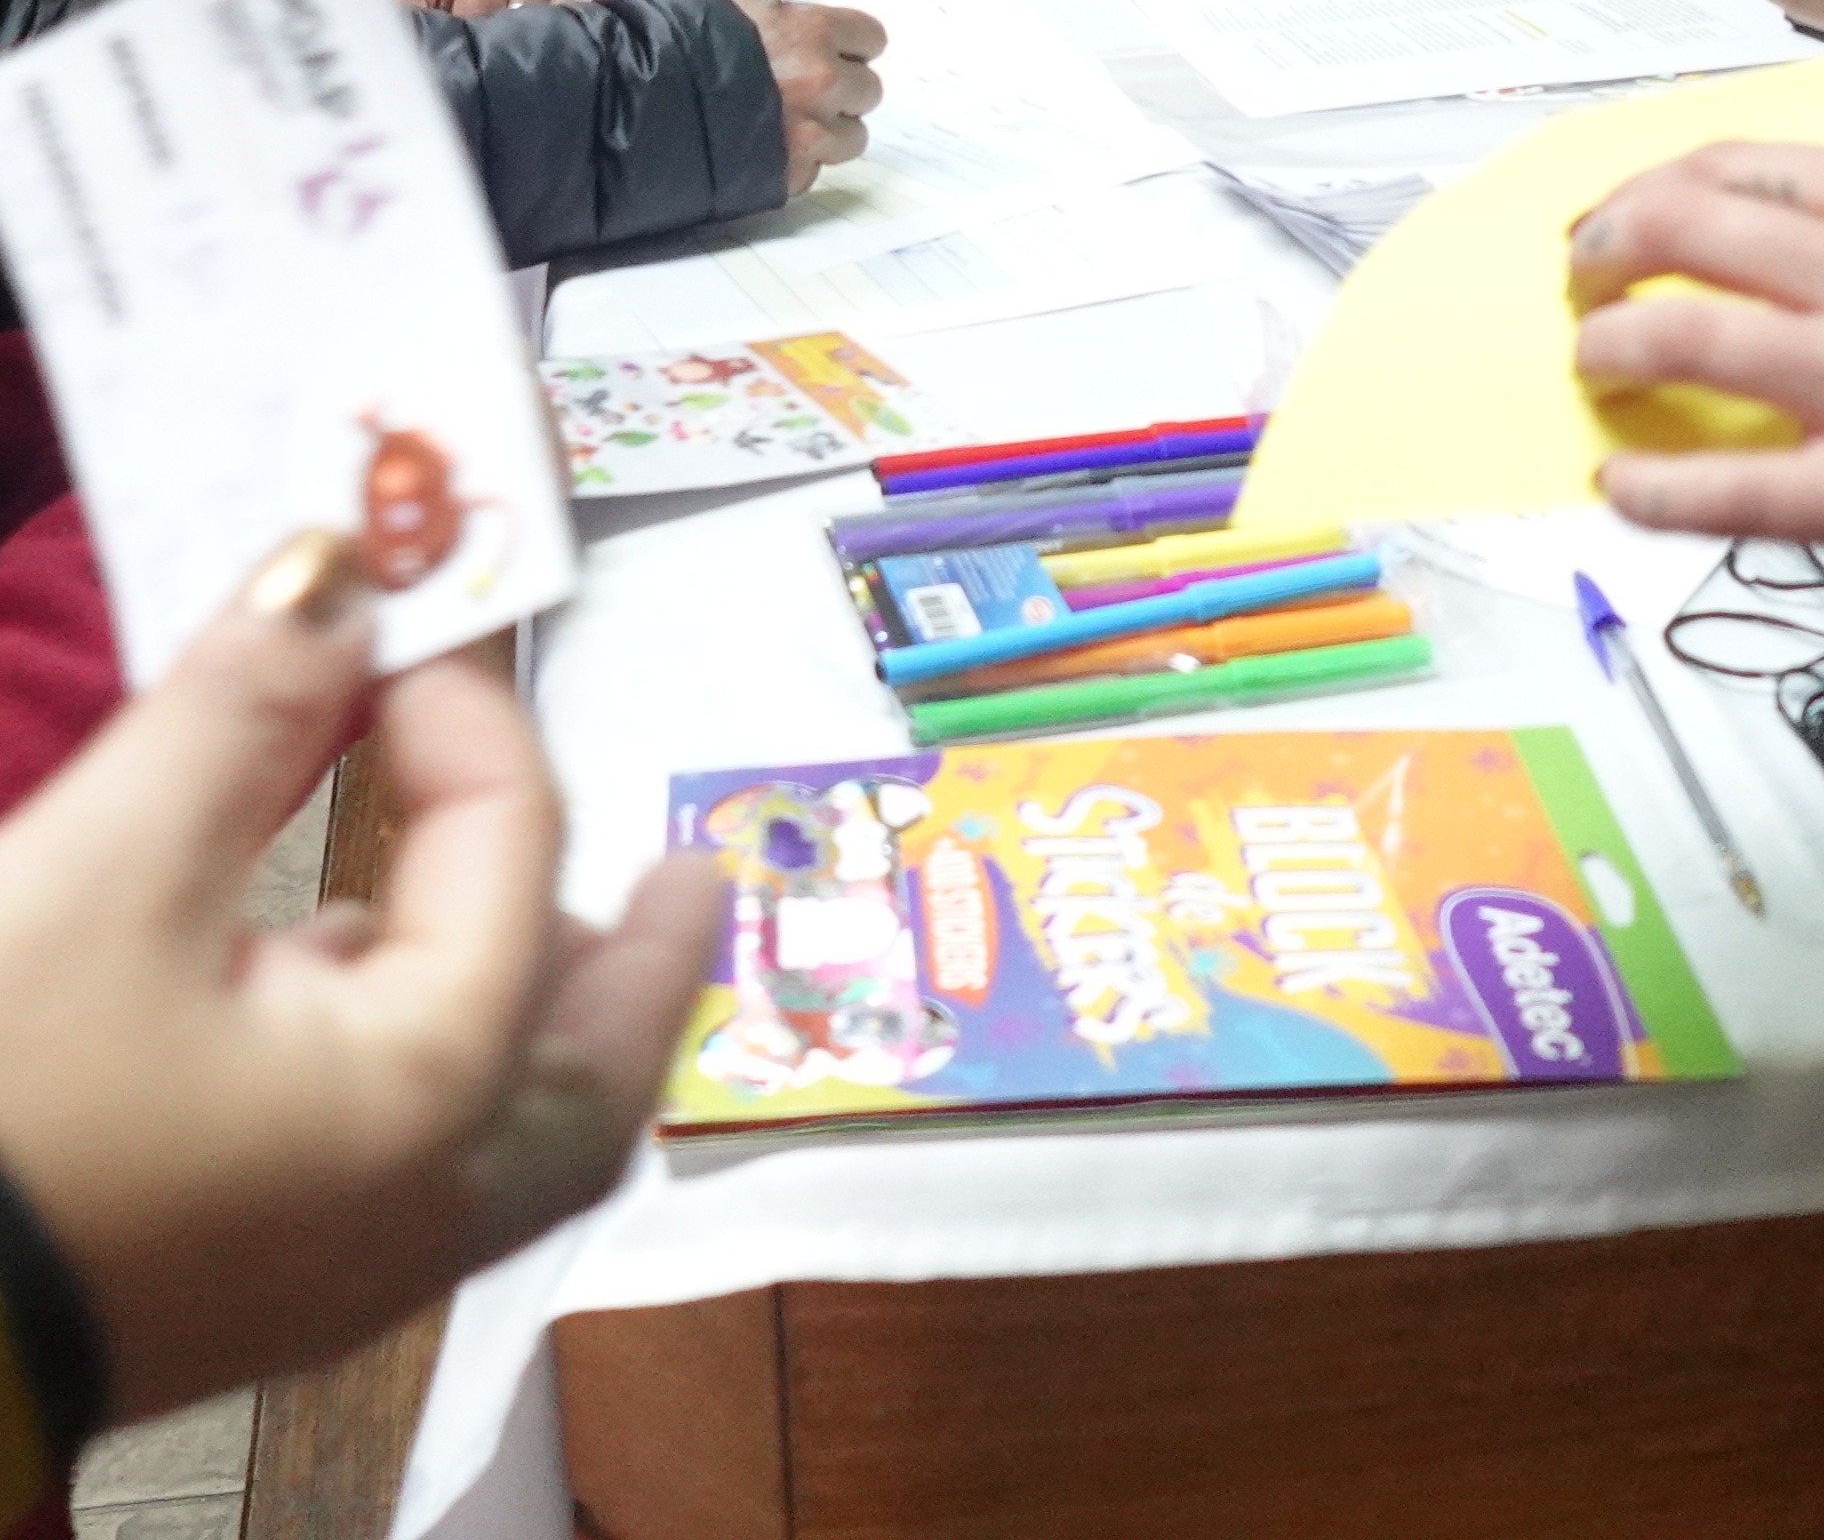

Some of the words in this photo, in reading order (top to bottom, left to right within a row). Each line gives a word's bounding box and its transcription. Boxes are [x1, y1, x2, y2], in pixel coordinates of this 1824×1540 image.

[1017, 782, 1191, 1044] STICKERS
[1163, 870, 1252, 926] de
[1230, 803, 1415, 993] BLOCK
[1477, 904, 1585, 1062] Adetec
